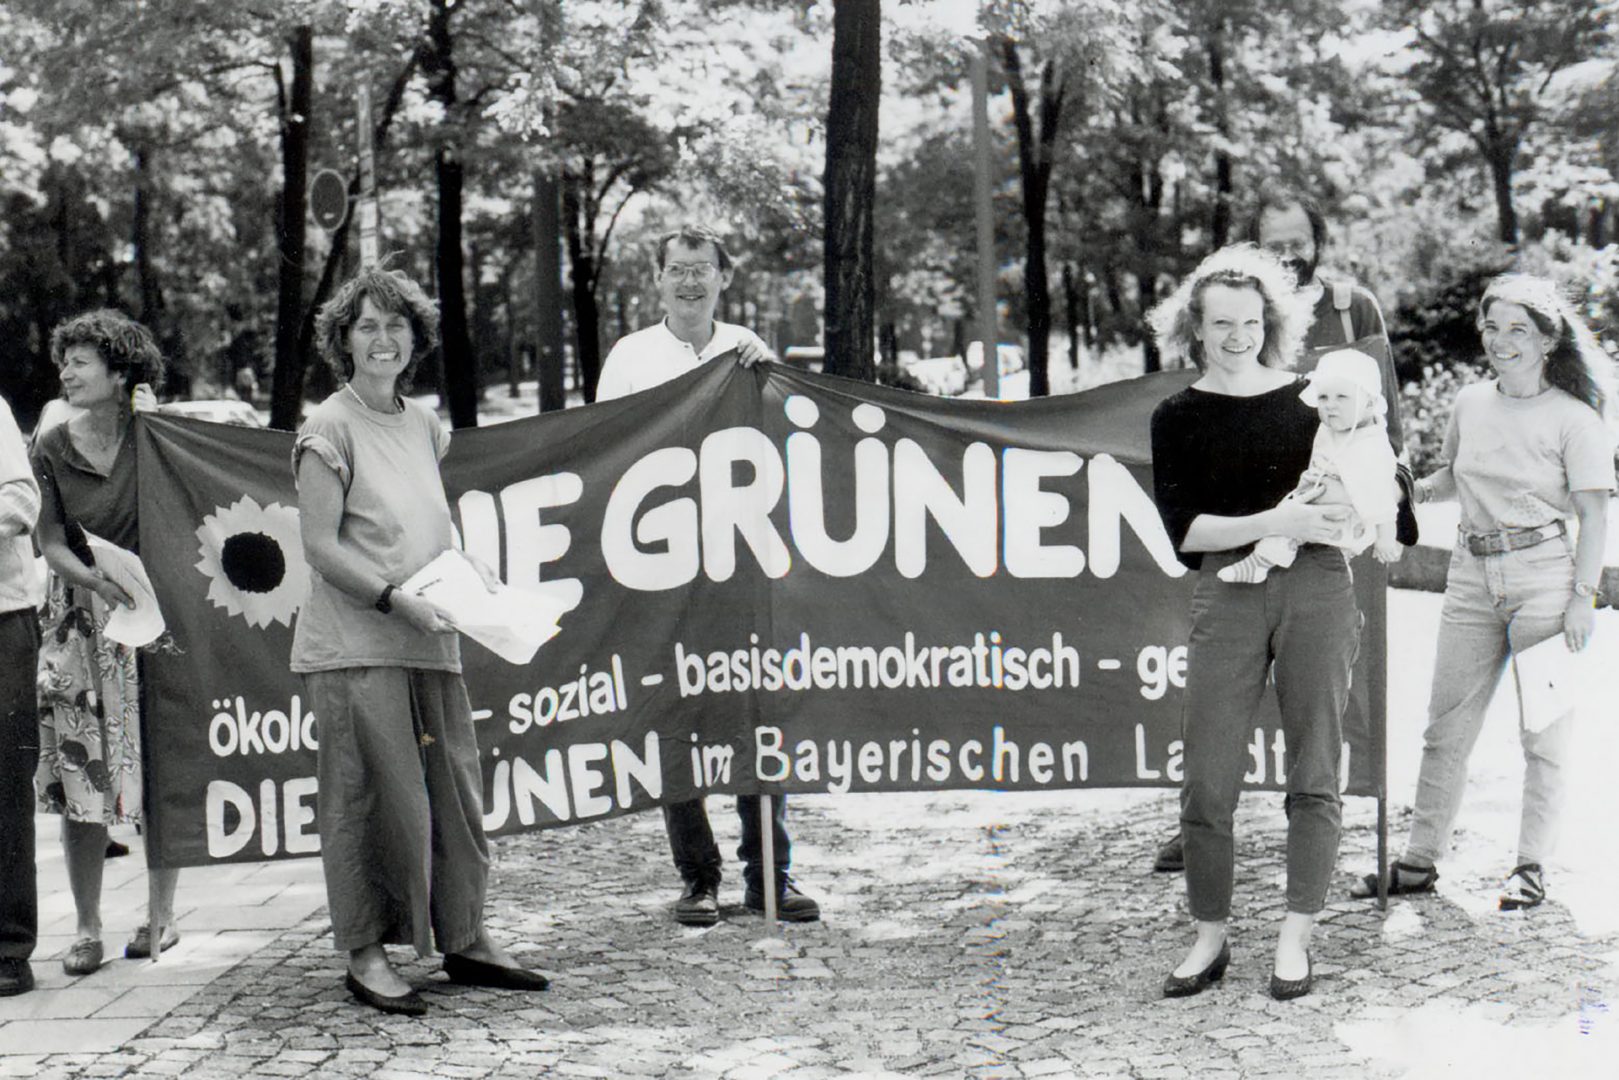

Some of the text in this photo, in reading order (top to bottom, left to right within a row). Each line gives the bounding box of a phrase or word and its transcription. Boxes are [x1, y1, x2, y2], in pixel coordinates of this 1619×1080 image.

[451, 395, 1188, 615] IE GRÜNEN
[208, 694, 320, 758] ökolo
[508, 655, 628, 734] sozial
[675, 631, 1080, 698] basisdemokratisch
[206, 723, 1351, 859] DIE ÜNEN im Bayerischen Ladt
